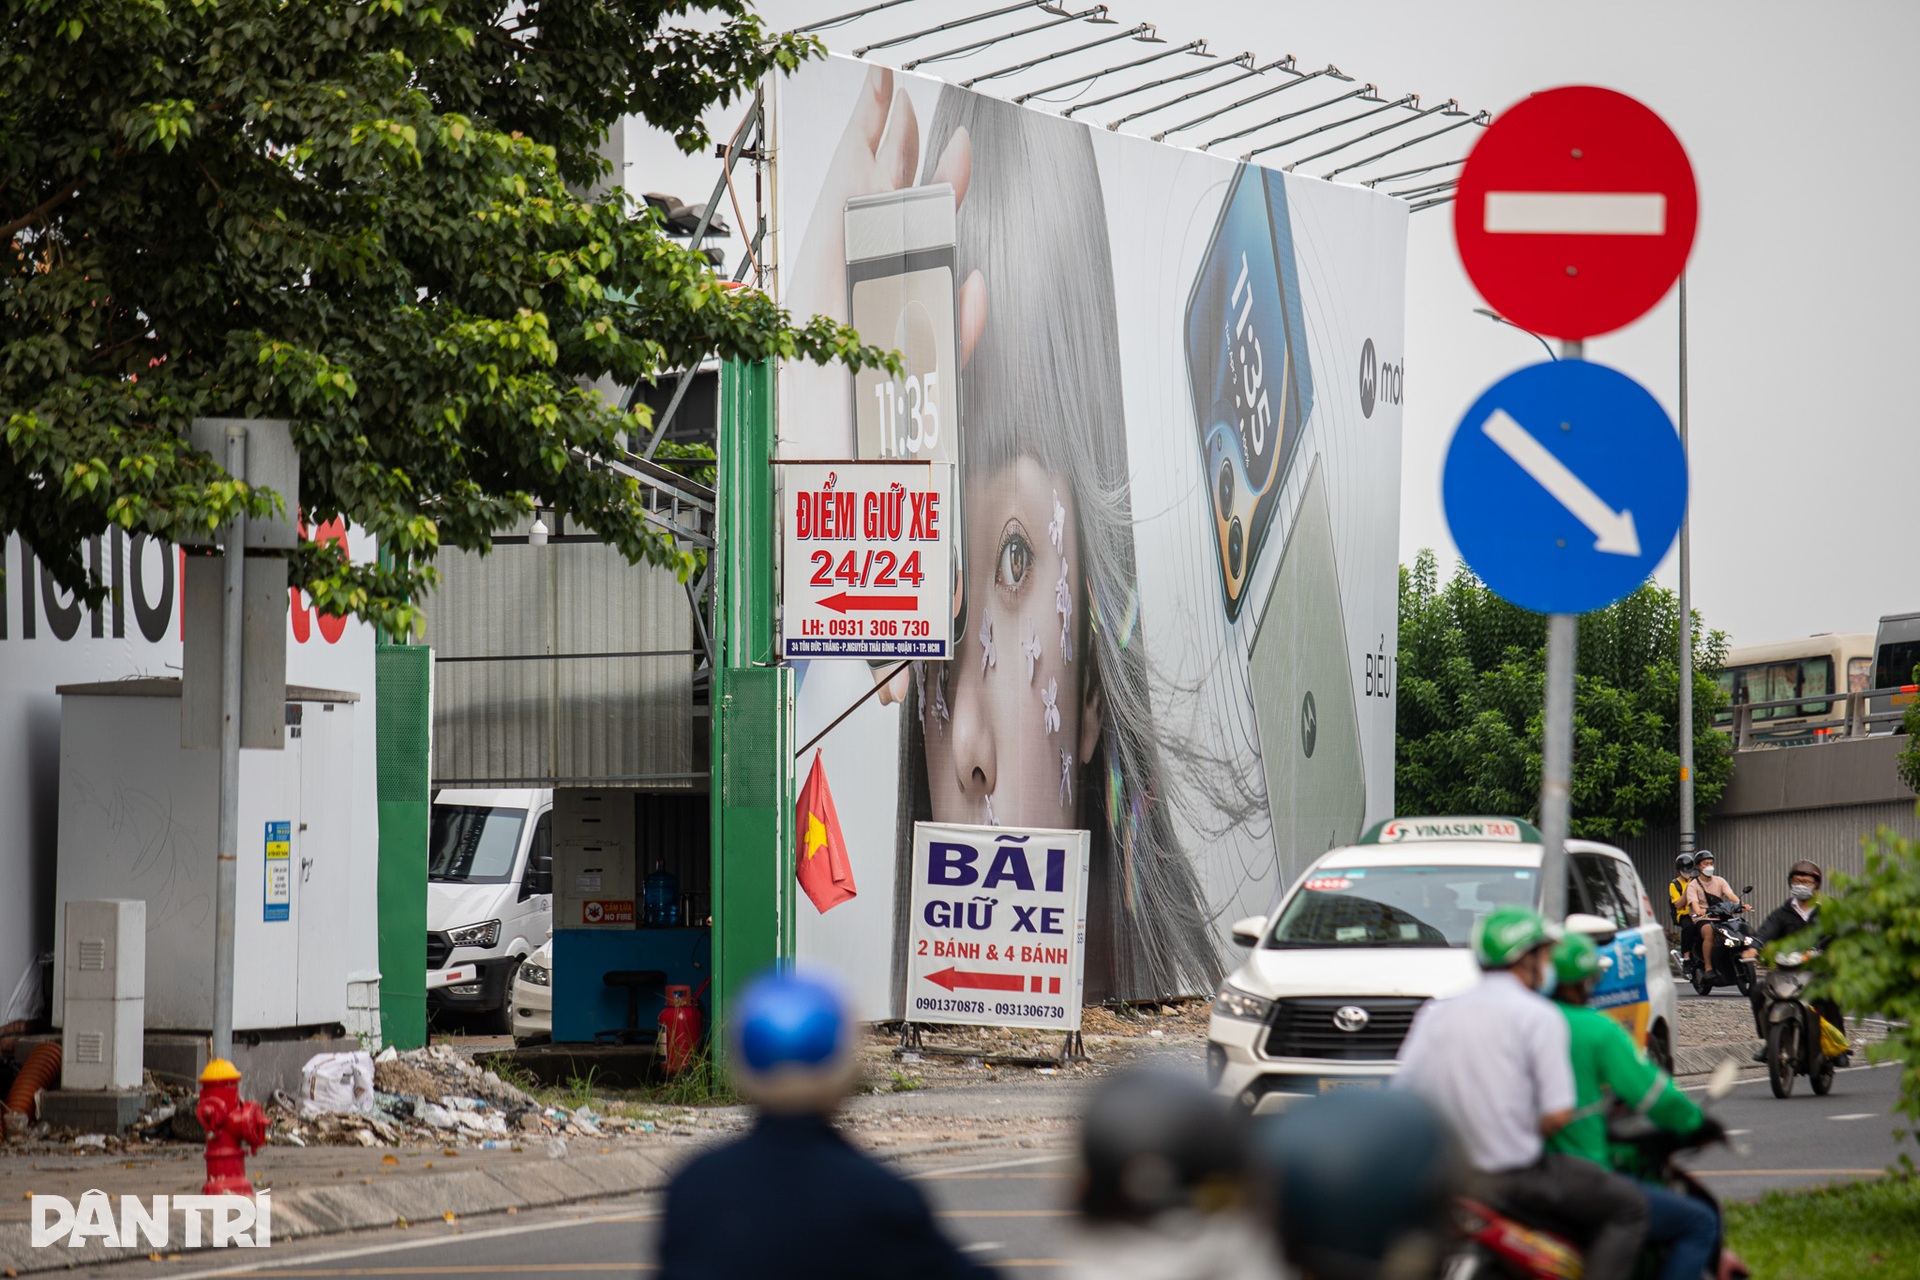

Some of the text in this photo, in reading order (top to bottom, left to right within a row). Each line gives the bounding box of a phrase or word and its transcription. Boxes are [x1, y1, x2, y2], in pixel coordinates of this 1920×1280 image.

[1231, 250, 1272, 456] 11:35
[875, 371, 939, 460] 11:35
[796, 471, 940, 541] ĐIỂM GIỮ XE
[810, 550, 925, 588] 24/24
[802, 619, 930, 637] LH: 0931 306 730
[1366, 633, 1391, 698] BIỂU
[1415, 823, 1515, 837] VINASUN TAXI
[928, 835, 1065, 892] BÃI
[604, 913, 632, 921] NO FIRE
[924, 896, 998, 930] GIỮ
[1010, 905, 1064, 934] XE
[917, 937, 1068, 965] 2 BÁNH & 4 BÁNH
[916, 997, 985, 1013] 0901370878
[995, 1002, 1064, 1019] 0931306730
